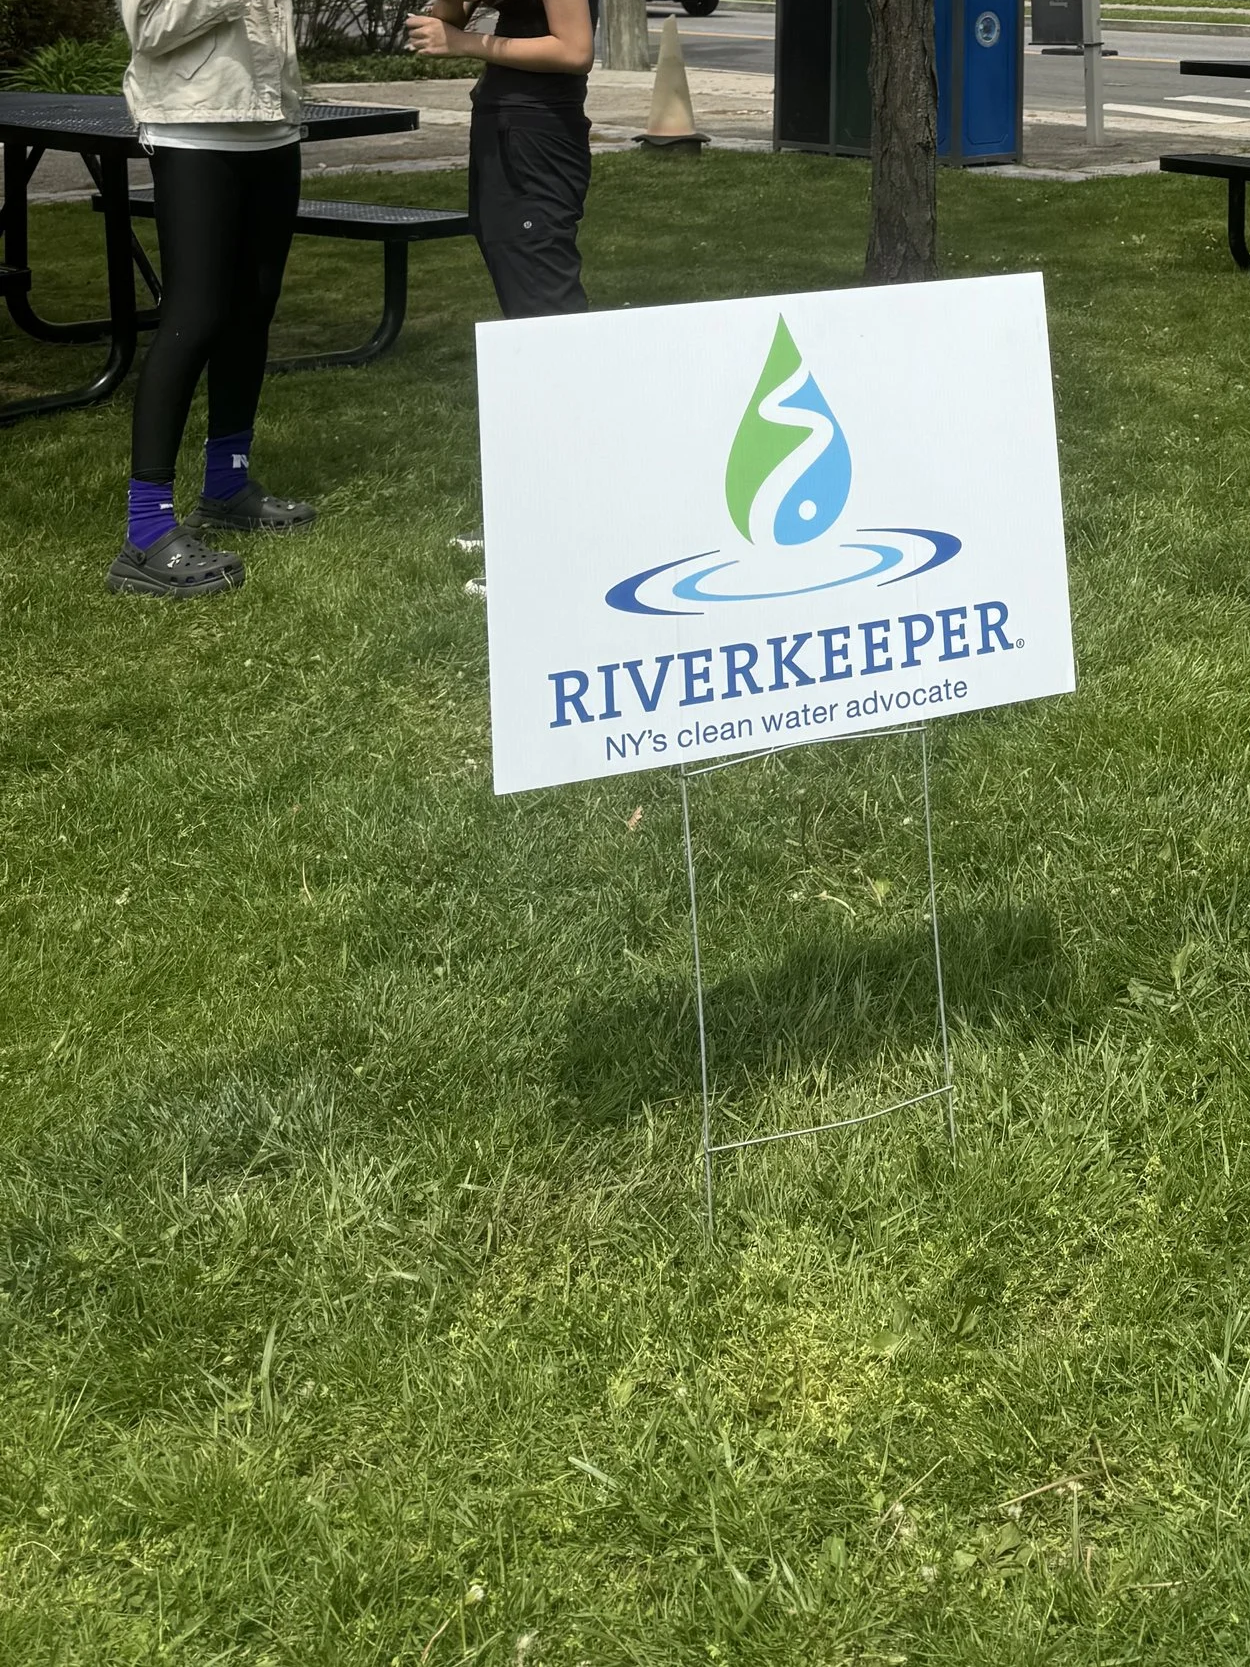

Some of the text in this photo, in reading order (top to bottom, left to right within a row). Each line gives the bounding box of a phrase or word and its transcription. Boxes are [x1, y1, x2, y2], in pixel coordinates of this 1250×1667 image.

[606, 679, 968, 761] NY's clean water advocate
